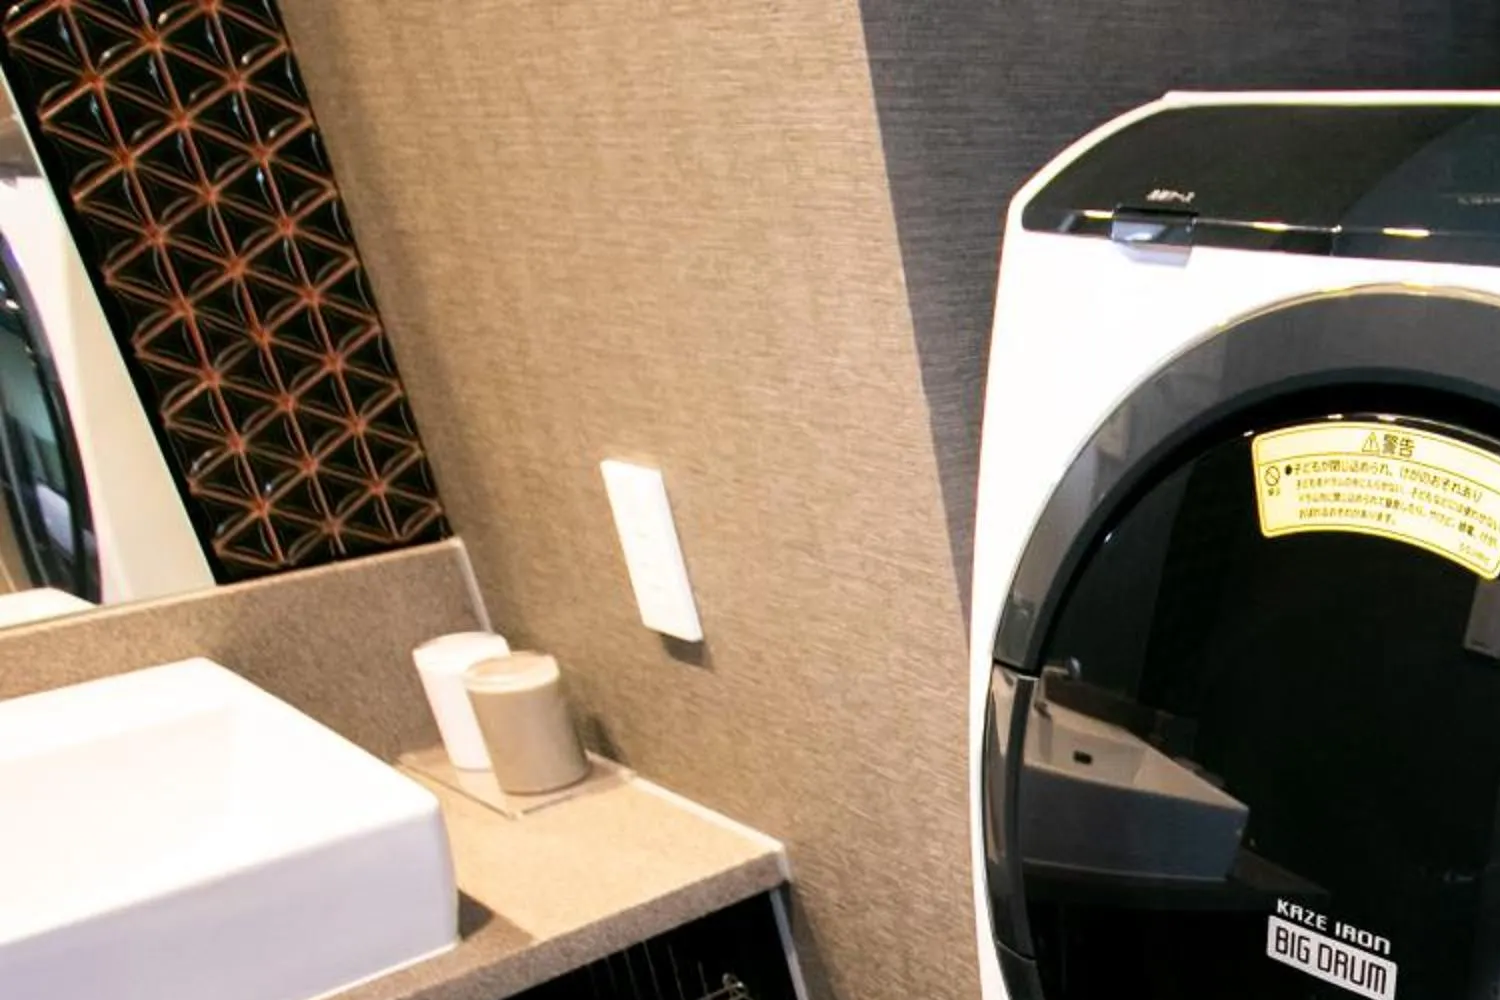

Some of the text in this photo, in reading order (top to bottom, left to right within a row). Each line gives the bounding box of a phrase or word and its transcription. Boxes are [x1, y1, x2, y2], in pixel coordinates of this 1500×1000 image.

[1383, 433, 1415, 458] 警告
[1276, 898, 1391, 955] KAZE IRON
[1274, 925, 1387, 995] BIG DRUM
